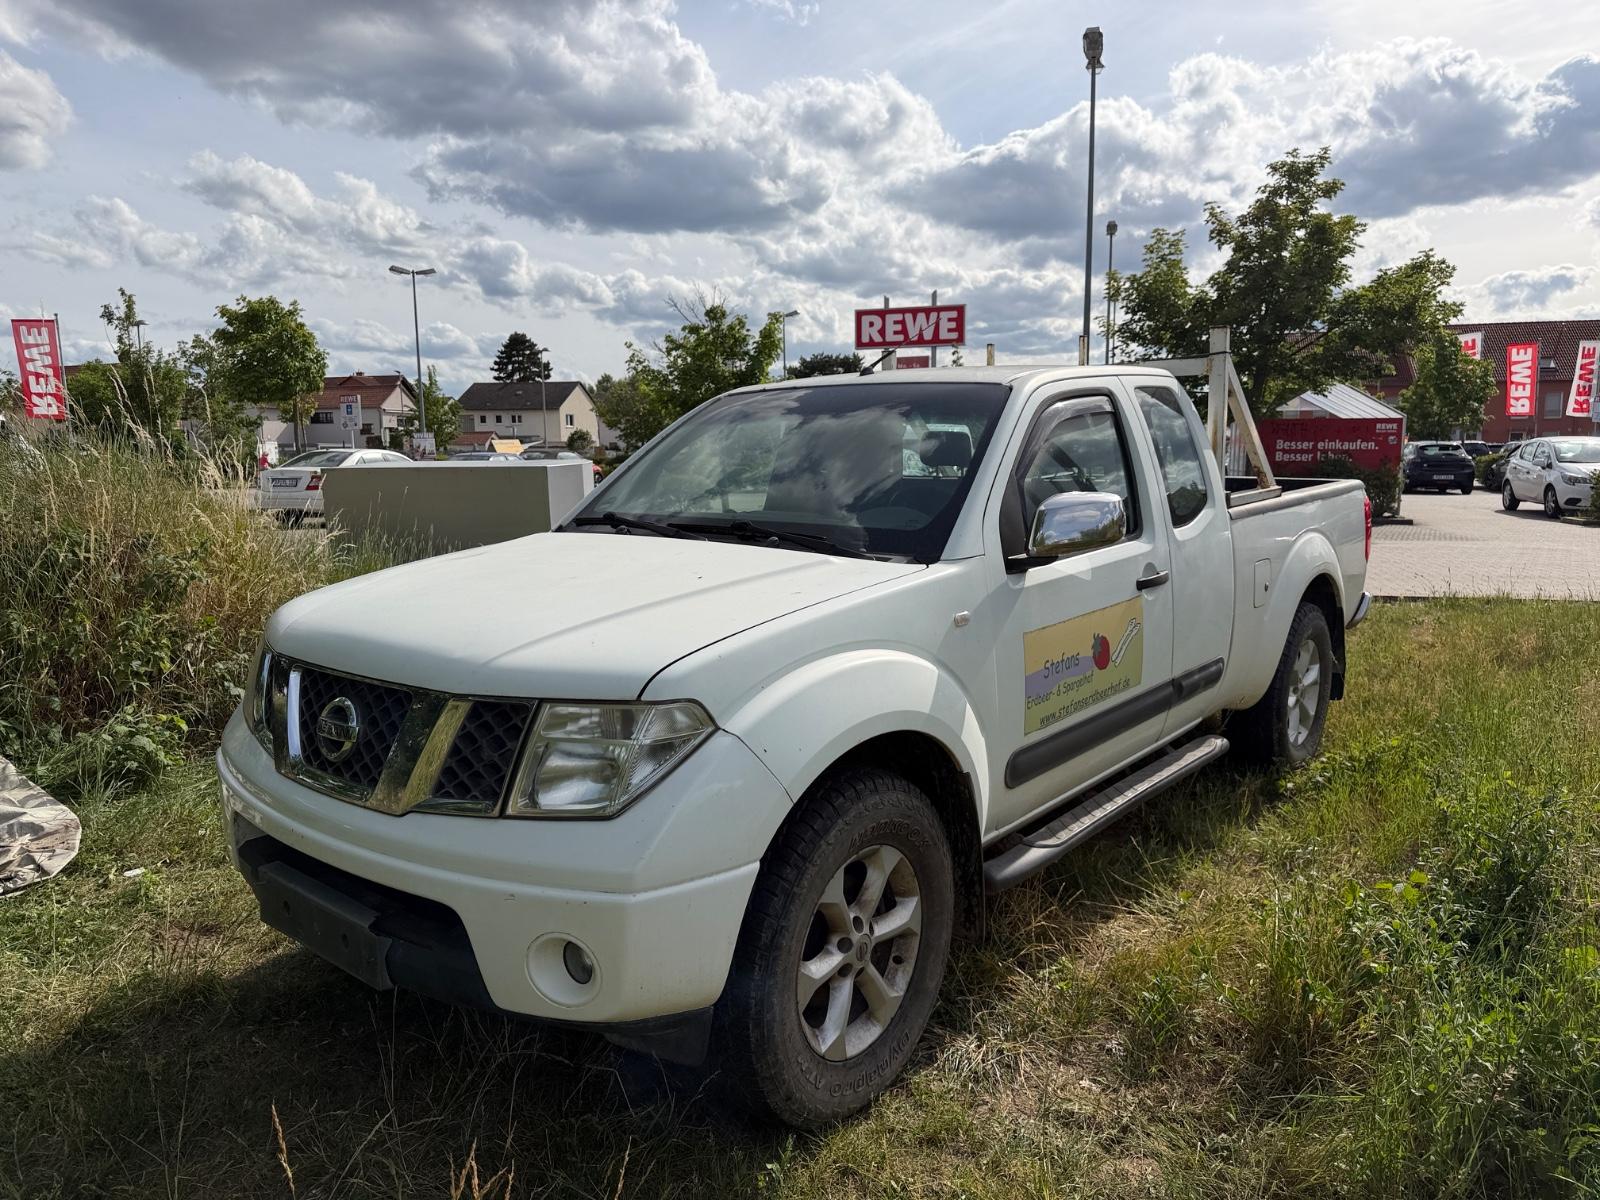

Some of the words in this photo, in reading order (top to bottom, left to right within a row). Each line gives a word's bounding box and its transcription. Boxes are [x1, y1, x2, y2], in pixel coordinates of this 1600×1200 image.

[860, 310, 960, 344] REWE
[340, 395, 357, 403] REWE
[1276, 439, 1314, 450] Besser
[1317, 438, 1379, 450] einkaufen.
[1275, 451, 1314, 462] Besser
[1043, 652, 1080, 679] Stefans
[1039, 676, 1131, 727] www.stefanserdbeerhof.de
